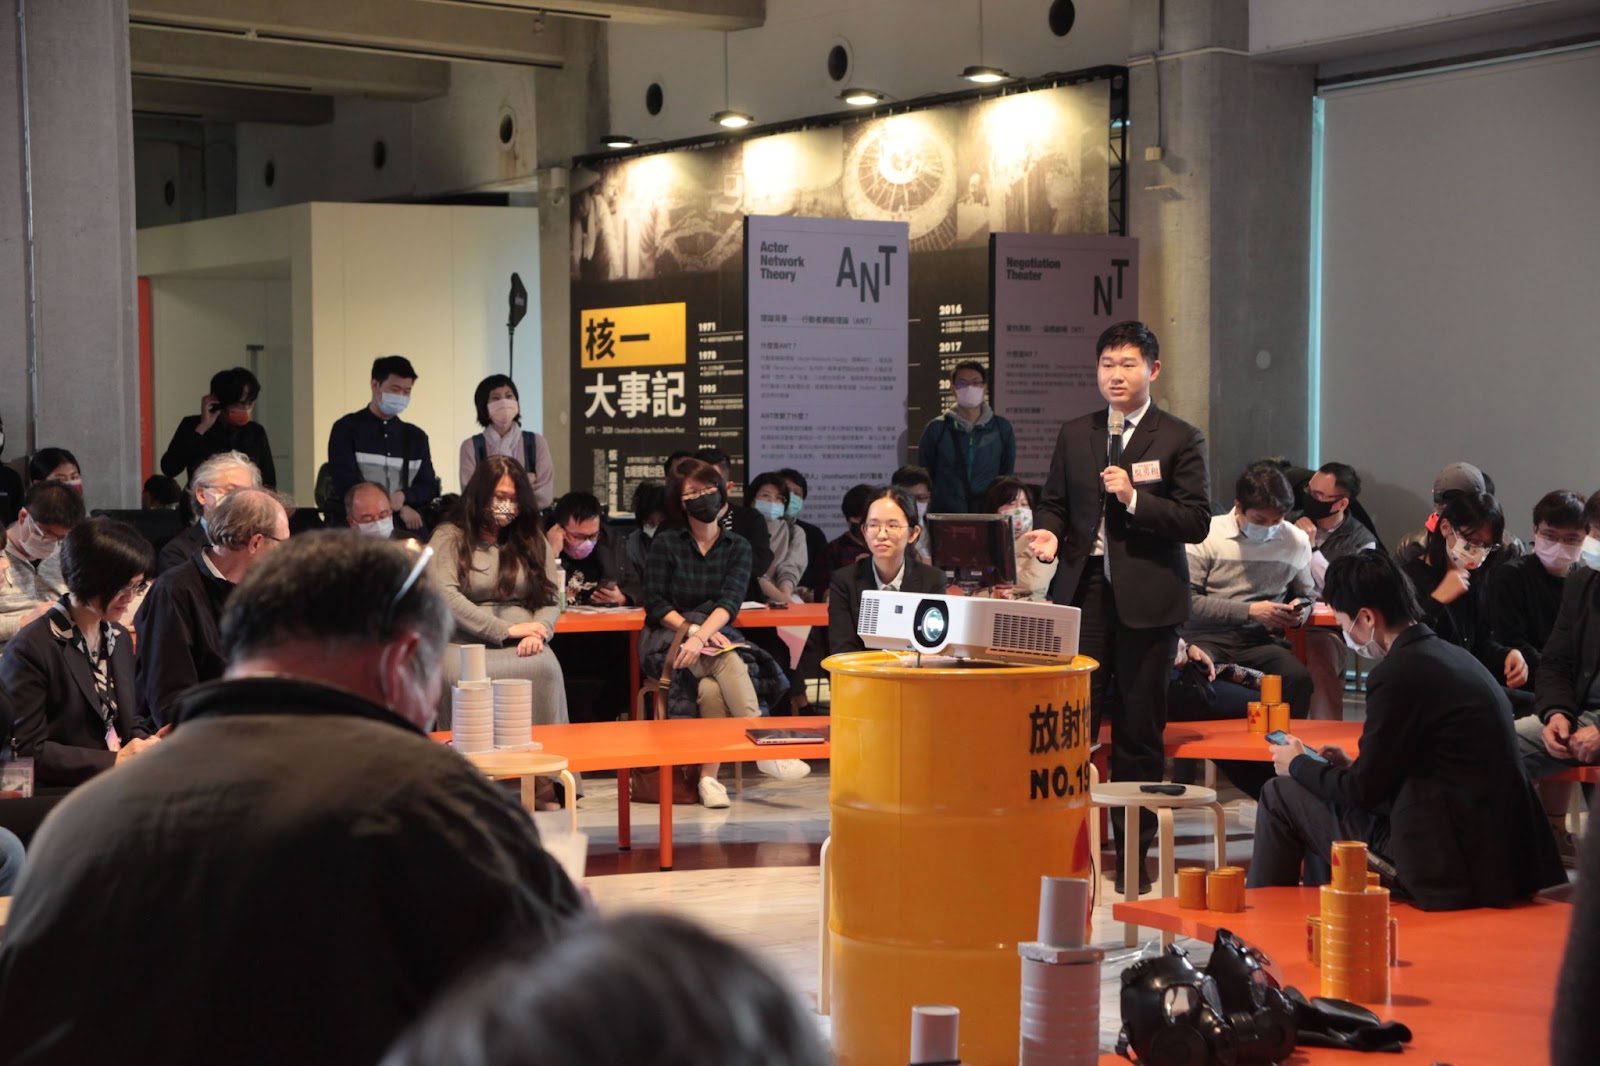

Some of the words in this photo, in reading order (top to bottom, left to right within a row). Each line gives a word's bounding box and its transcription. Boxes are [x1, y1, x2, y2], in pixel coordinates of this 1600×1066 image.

[760, 241, 789, 253] Actor
[760, 255, 805, 267] Network
[1006, 256, 1061, 270] Negotiation
[760, 268, 796, 282] Theory
[836, 245, 897, 303] ANT
[1006, 269, 1042, 281] Theater
[1093, 259, 1130, 316] NT
[939, 304, 962, 315] 2016
[698, 322, 716, 332] 1971
[586, 317, 650, 361] 核一
[939, 342, 962, 353] 2017
[698, 351, 717, 360] 1978
[585, 370, 687, 418] 大事記
[698, 384, 717, 394] 1995
[698, 417, 717, 426] 1997
